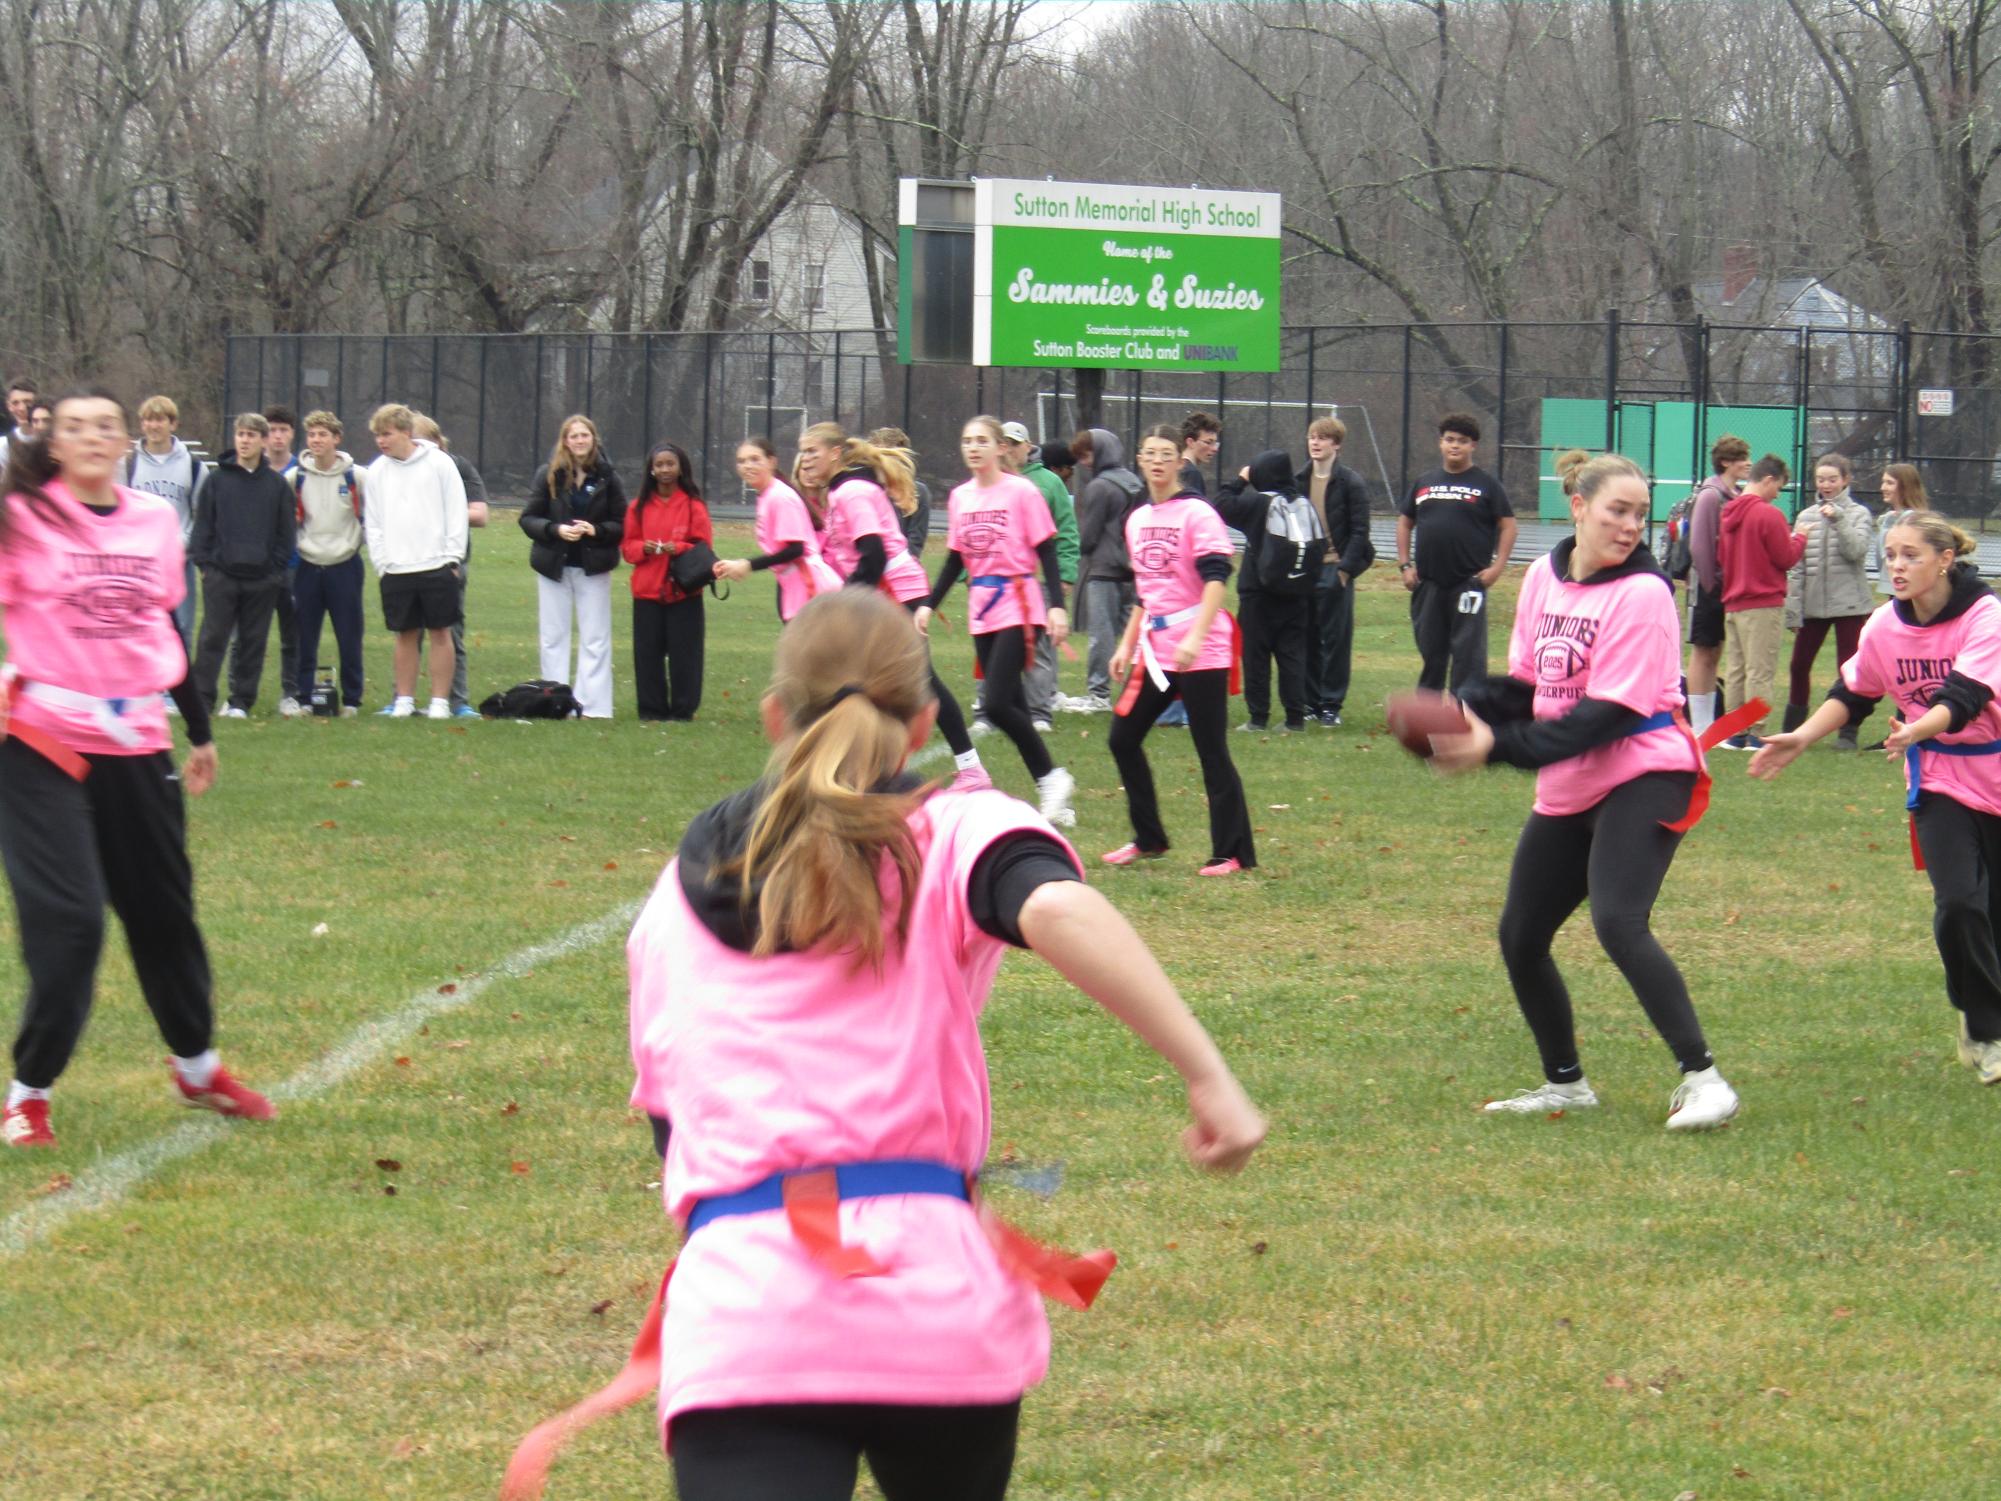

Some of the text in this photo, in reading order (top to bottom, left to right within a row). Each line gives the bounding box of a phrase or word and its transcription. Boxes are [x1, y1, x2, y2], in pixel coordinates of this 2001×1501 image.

[1014, 192, 1261, 230] Sutton Memorial High School
[1102, 240, 1173, 264] Home of the
[1008, 267, 1264, 311] Sammies & Suzies
[1086, 324, 1189, 340] Scoreboards provided by the
[1033, 340, 1238, 362] Sutton Booster Club and UNIBANK
[135, 479, 185, 500] ONDON
[1449, 486, 1482, 497] POLO
[1458, 590, 1483, 615] 07
[1534, 613, 1599, 648] JUNIORS
[1543, 655, 1564, 670] 2025
[1896, 658, 1956, 685] JUNIO
